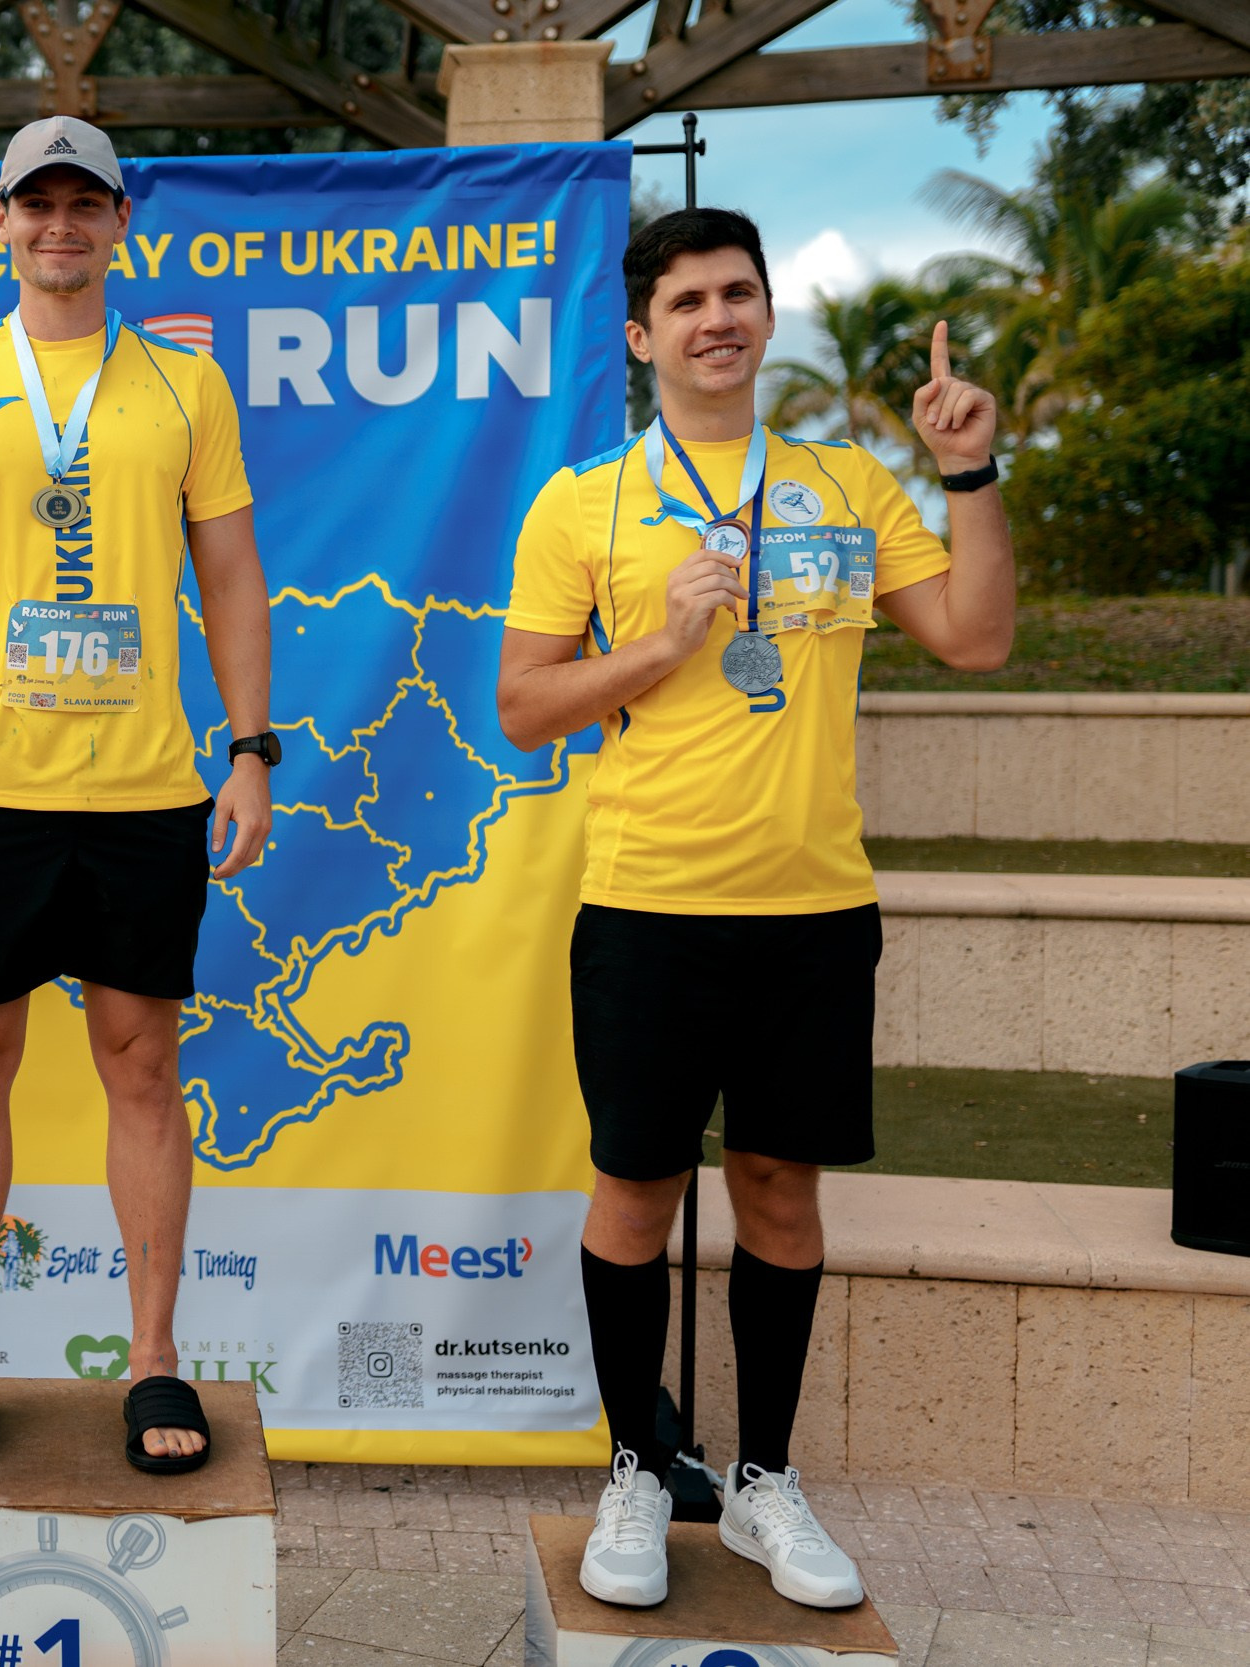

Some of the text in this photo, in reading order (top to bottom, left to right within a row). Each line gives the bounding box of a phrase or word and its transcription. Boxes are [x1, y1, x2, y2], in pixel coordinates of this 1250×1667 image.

[44, 146, 77, 155] adidas
[104, 234, 174, 279] AY
[188, 231, 266, 276] OF
[280, 220, 556, 275] UKRAINE!
[248, 297, 552, 407] RUN
[760, 533, 862, 545] RAZOM RUN
[854, 555, 868, 563] 5K
[789, 550, 840, 594] 52
[21, 606, 128, 621] RAZOM RUN
[123, 631, 135, 639] 5K
[39, 630, 109, 676] 176
[63, 698, 91, 706] SLAVA
[375, 1234, 524, 1279] Meest
[46, 1246, 102, 1284] Split
[193, 1249, 258, 1291] Timing
[180, 1339, 275, 1354] RMER'S
[435, 1338, 570, 1356] dr.kutsenko
[437, 1370, 543, 1382] massage therapist
[437, 1385, 576, 1397] physical rehabilitologist
